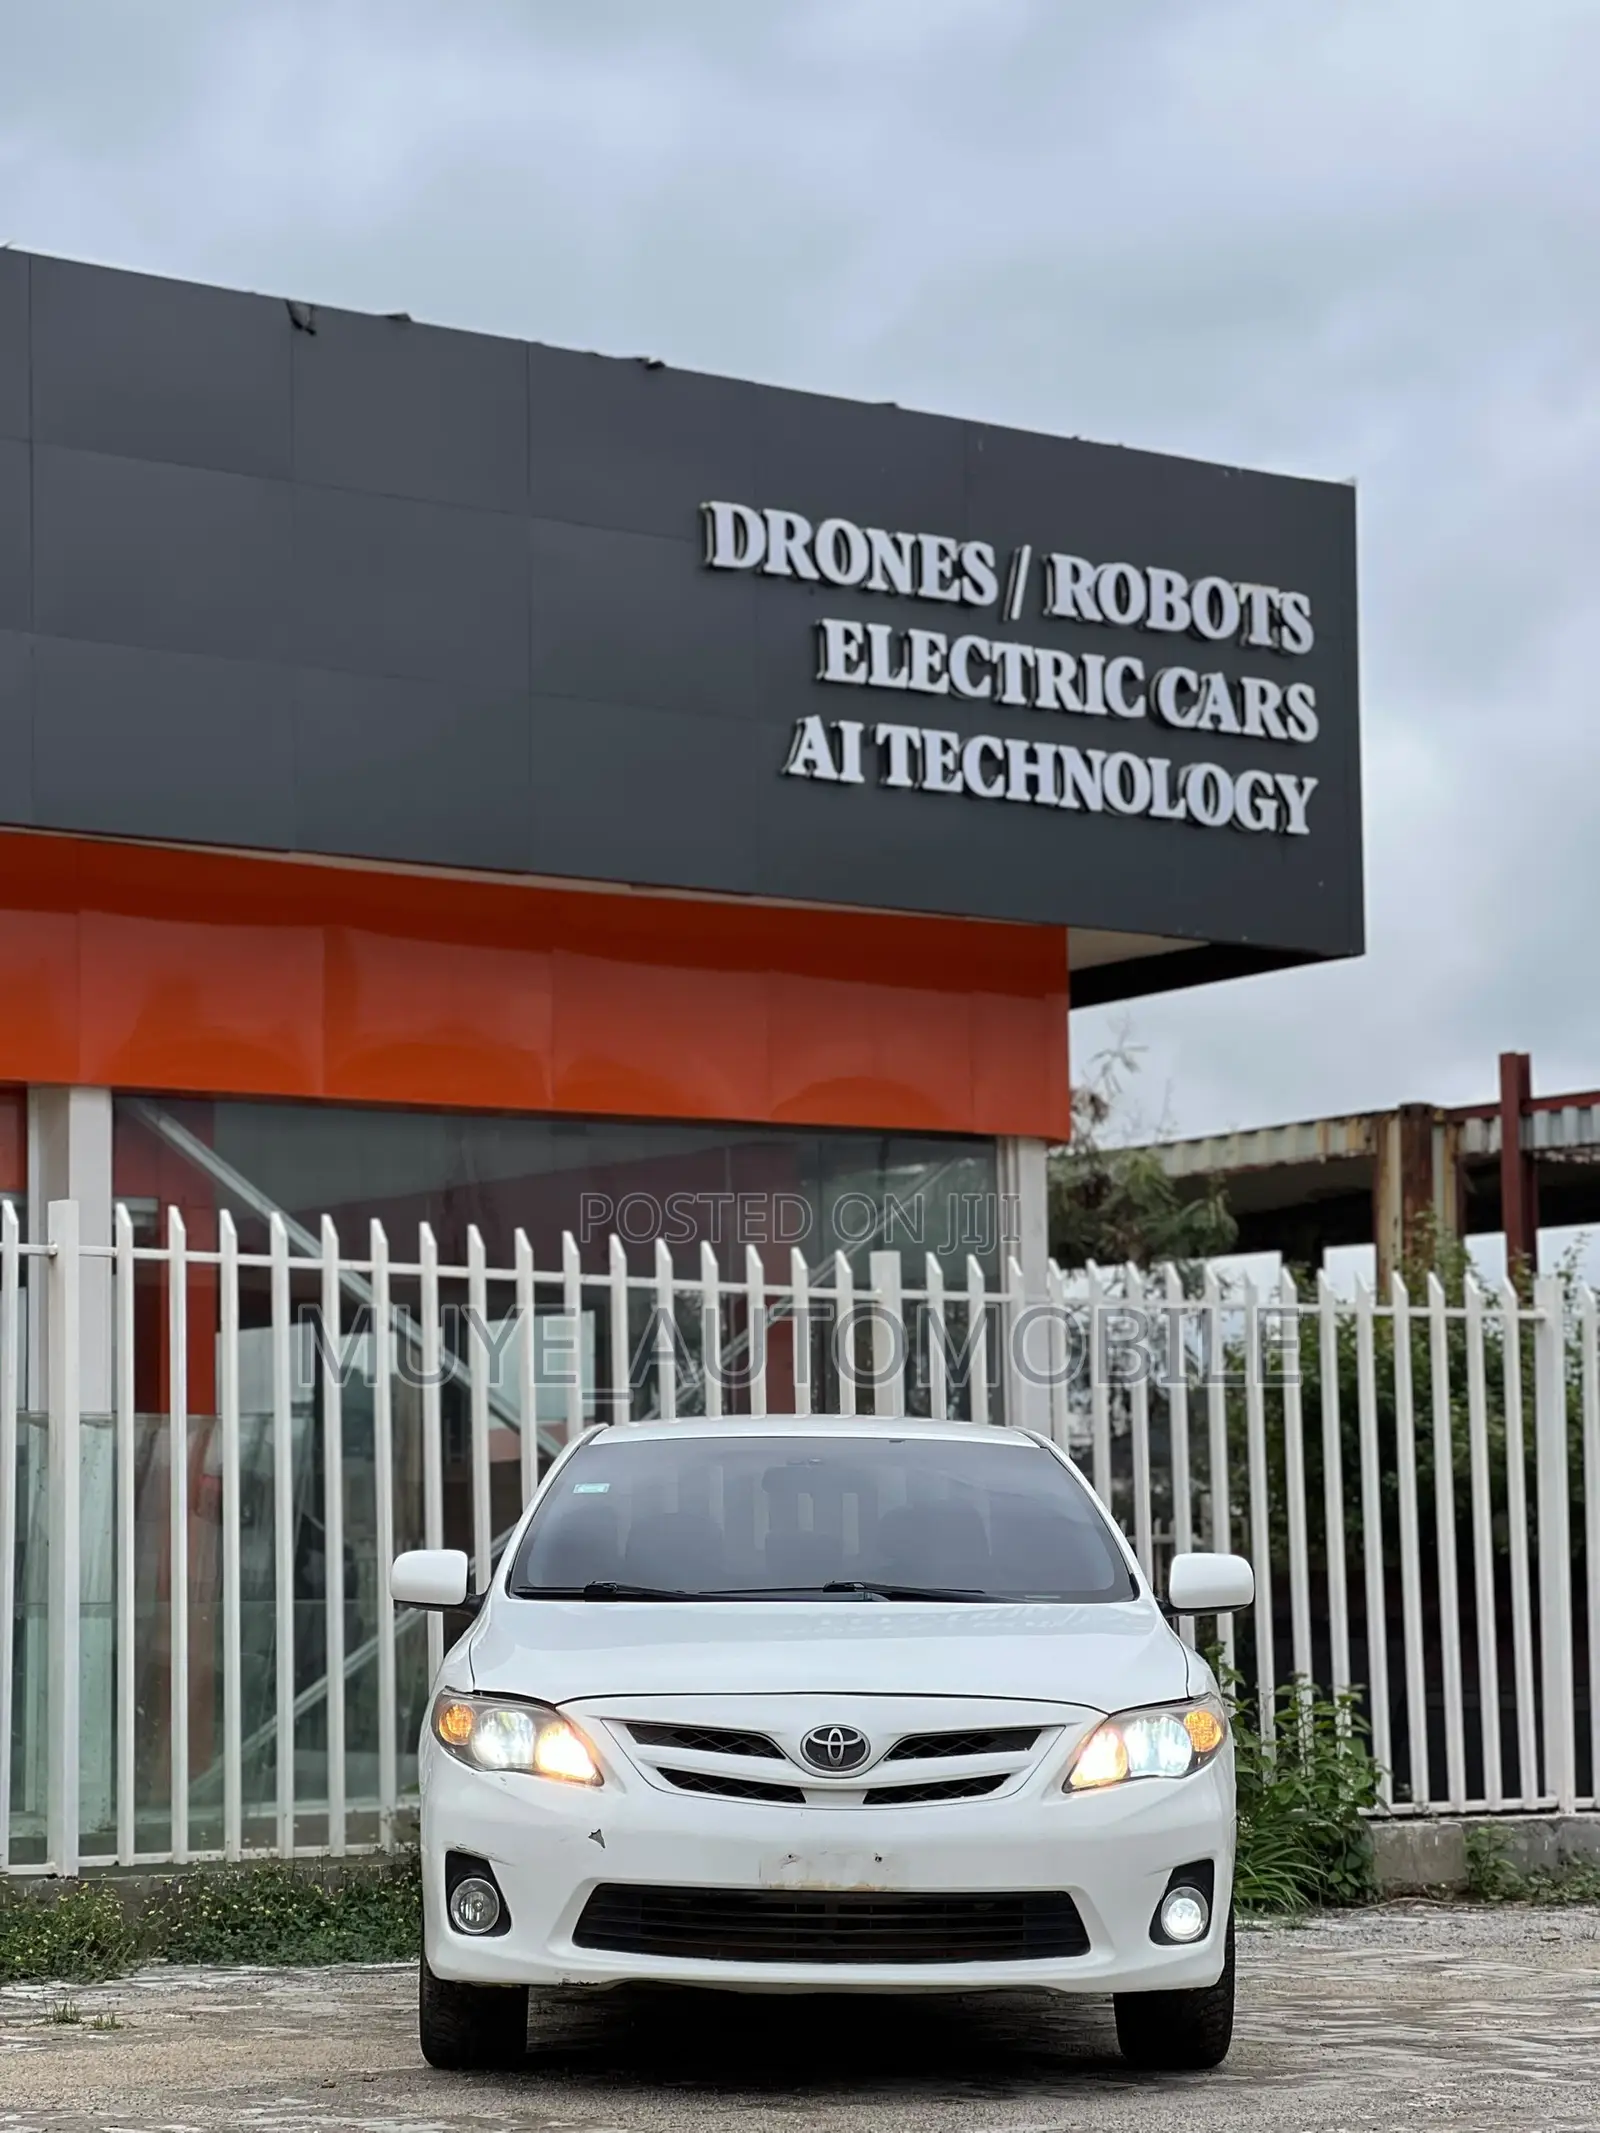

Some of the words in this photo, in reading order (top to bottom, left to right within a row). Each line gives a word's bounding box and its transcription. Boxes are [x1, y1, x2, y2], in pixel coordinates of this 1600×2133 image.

[702, 500, 999, 607] DRONES
[1003, 544, 1032, 621] /
[1043, 552, 1315, 655] ROBOTS
[816, 618, 1146, 719] ELECTRIC
[1152, 665, 1320, 743] CARS
[783, 715, 865, 784] AI
[872, 722, 1319, 836] TECHNOLOGY
